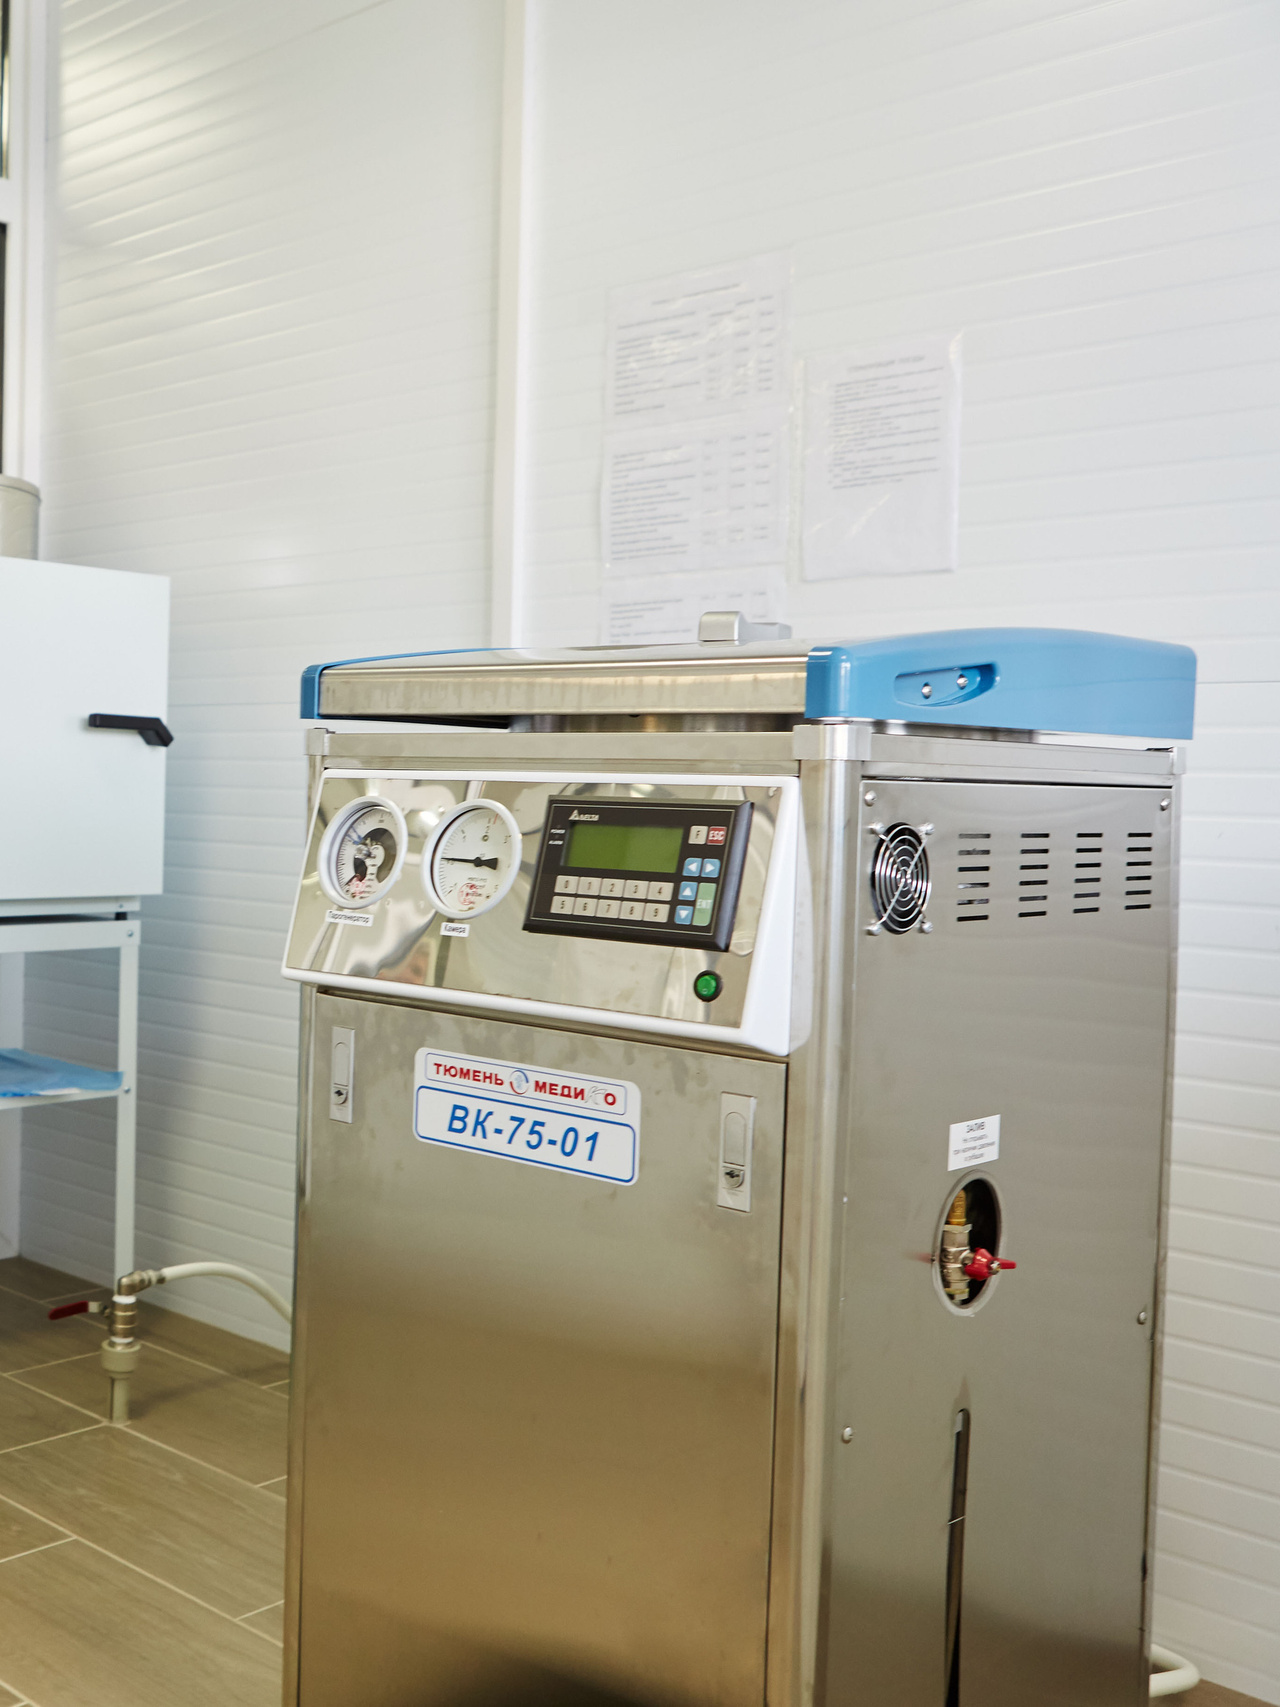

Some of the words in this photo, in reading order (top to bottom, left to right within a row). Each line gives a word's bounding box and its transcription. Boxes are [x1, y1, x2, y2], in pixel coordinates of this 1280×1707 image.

[708, 830, 725, 840] ESC
[433, 1062, 504, 1086] ТЮМЕНЬ
[447, 1104, 599, 1162] ВК-75-01
